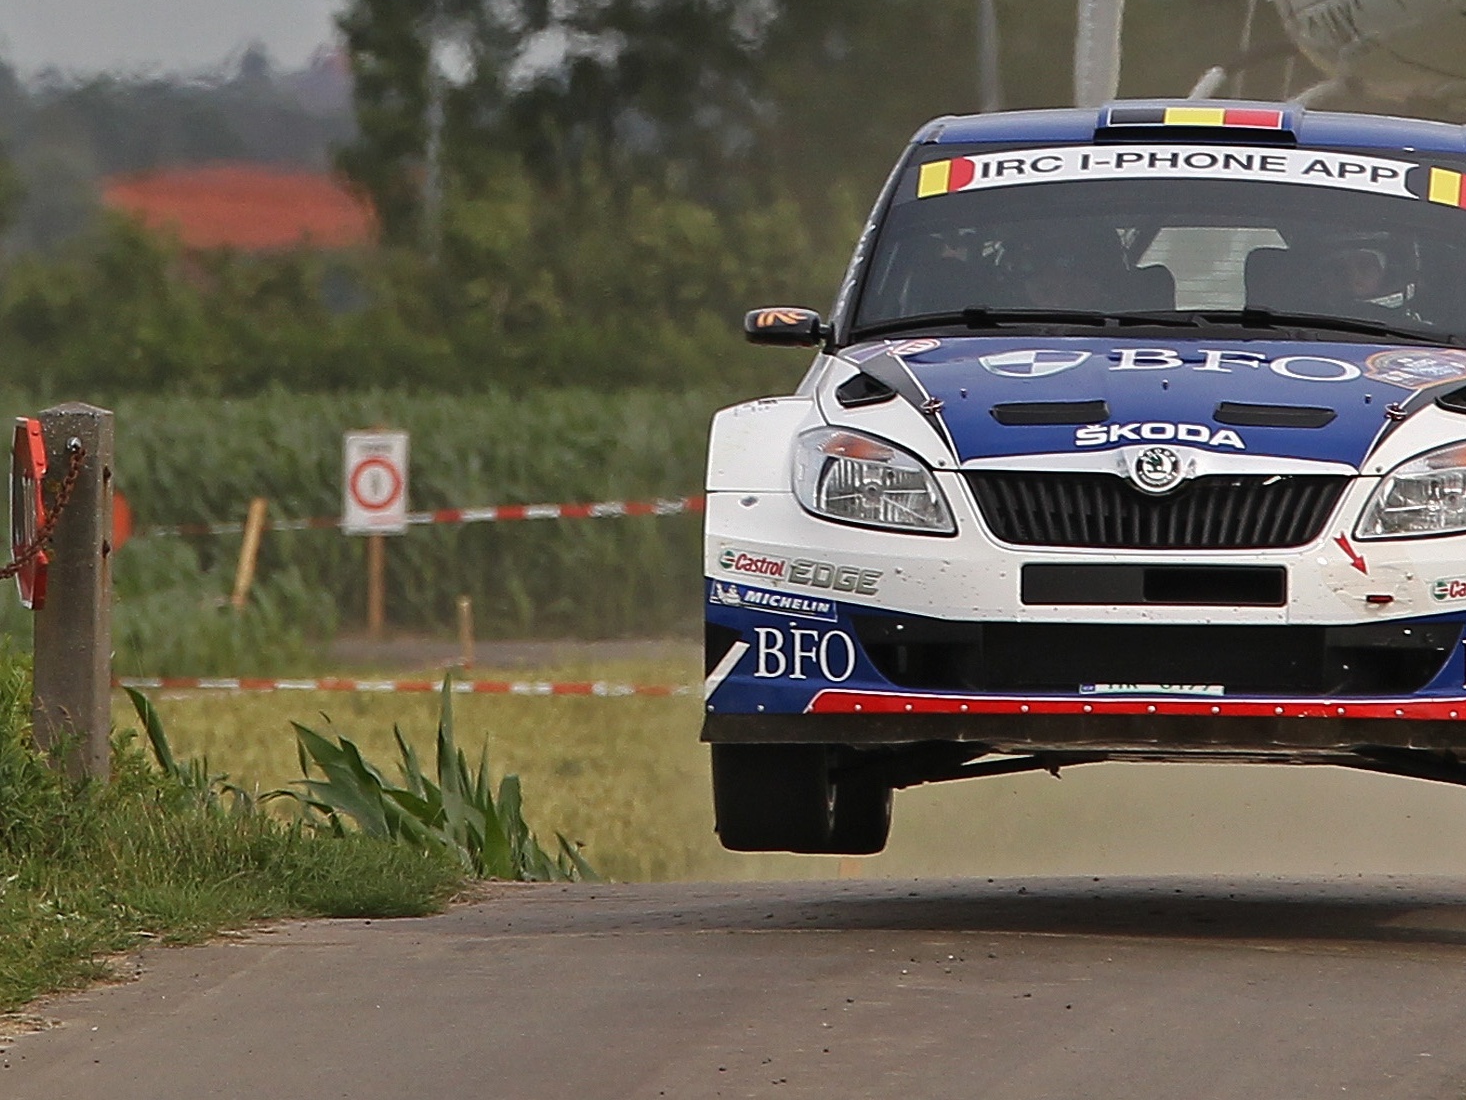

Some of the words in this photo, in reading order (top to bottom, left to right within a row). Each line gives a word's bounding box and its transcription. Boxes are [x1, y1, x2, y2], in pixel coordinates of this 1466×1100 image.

[980, 156, 1063, 179] IRC
[1080, 152, 1287, 173] I-PHONE
[1302, 159, 1400, 184] APP
[1108, 348, 1362, 382] BFO
[1075, 422, 1246, 449] ŠKODA
[734, 553, 786, 578] Castrol
[788, 558, 884, 596] EDGE
[744, 591, 830, 613] MICHELIN
[753, 627, 856, 682] BFO
